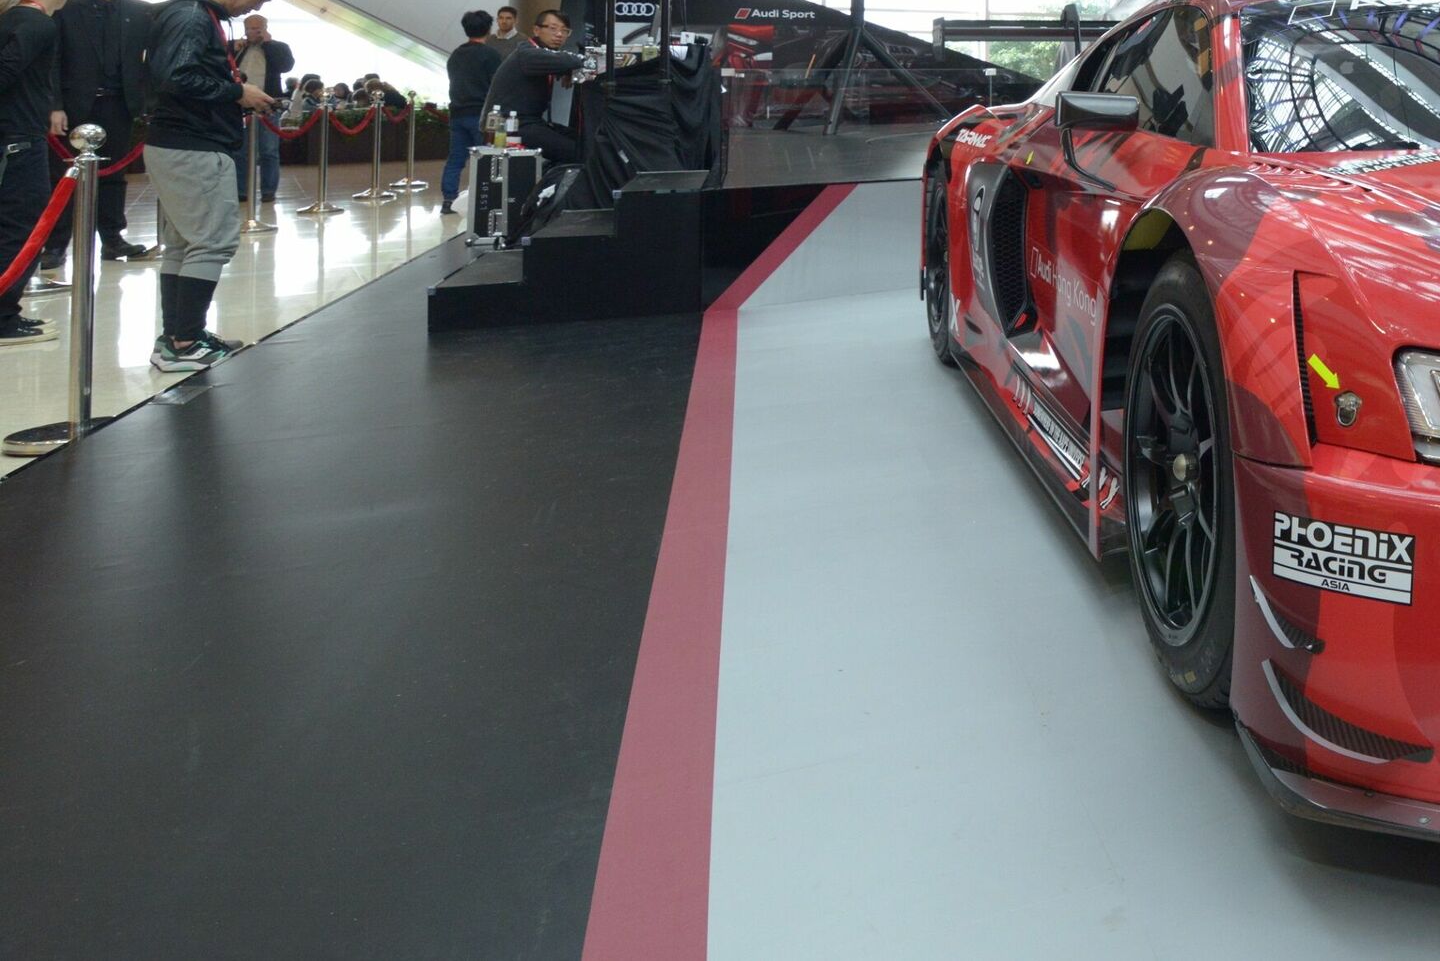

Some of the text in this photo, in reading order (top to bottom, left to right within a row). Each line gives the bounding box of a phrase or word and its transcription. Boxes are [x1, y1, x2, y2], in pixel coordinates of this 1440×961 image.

[751, 8, 816, 20] Audi Sport
[1052, 263, 1072, 307] Hong
[1073, 279, 1097, 327] Kong
[1321, 579, 1350, 592] ASIA
